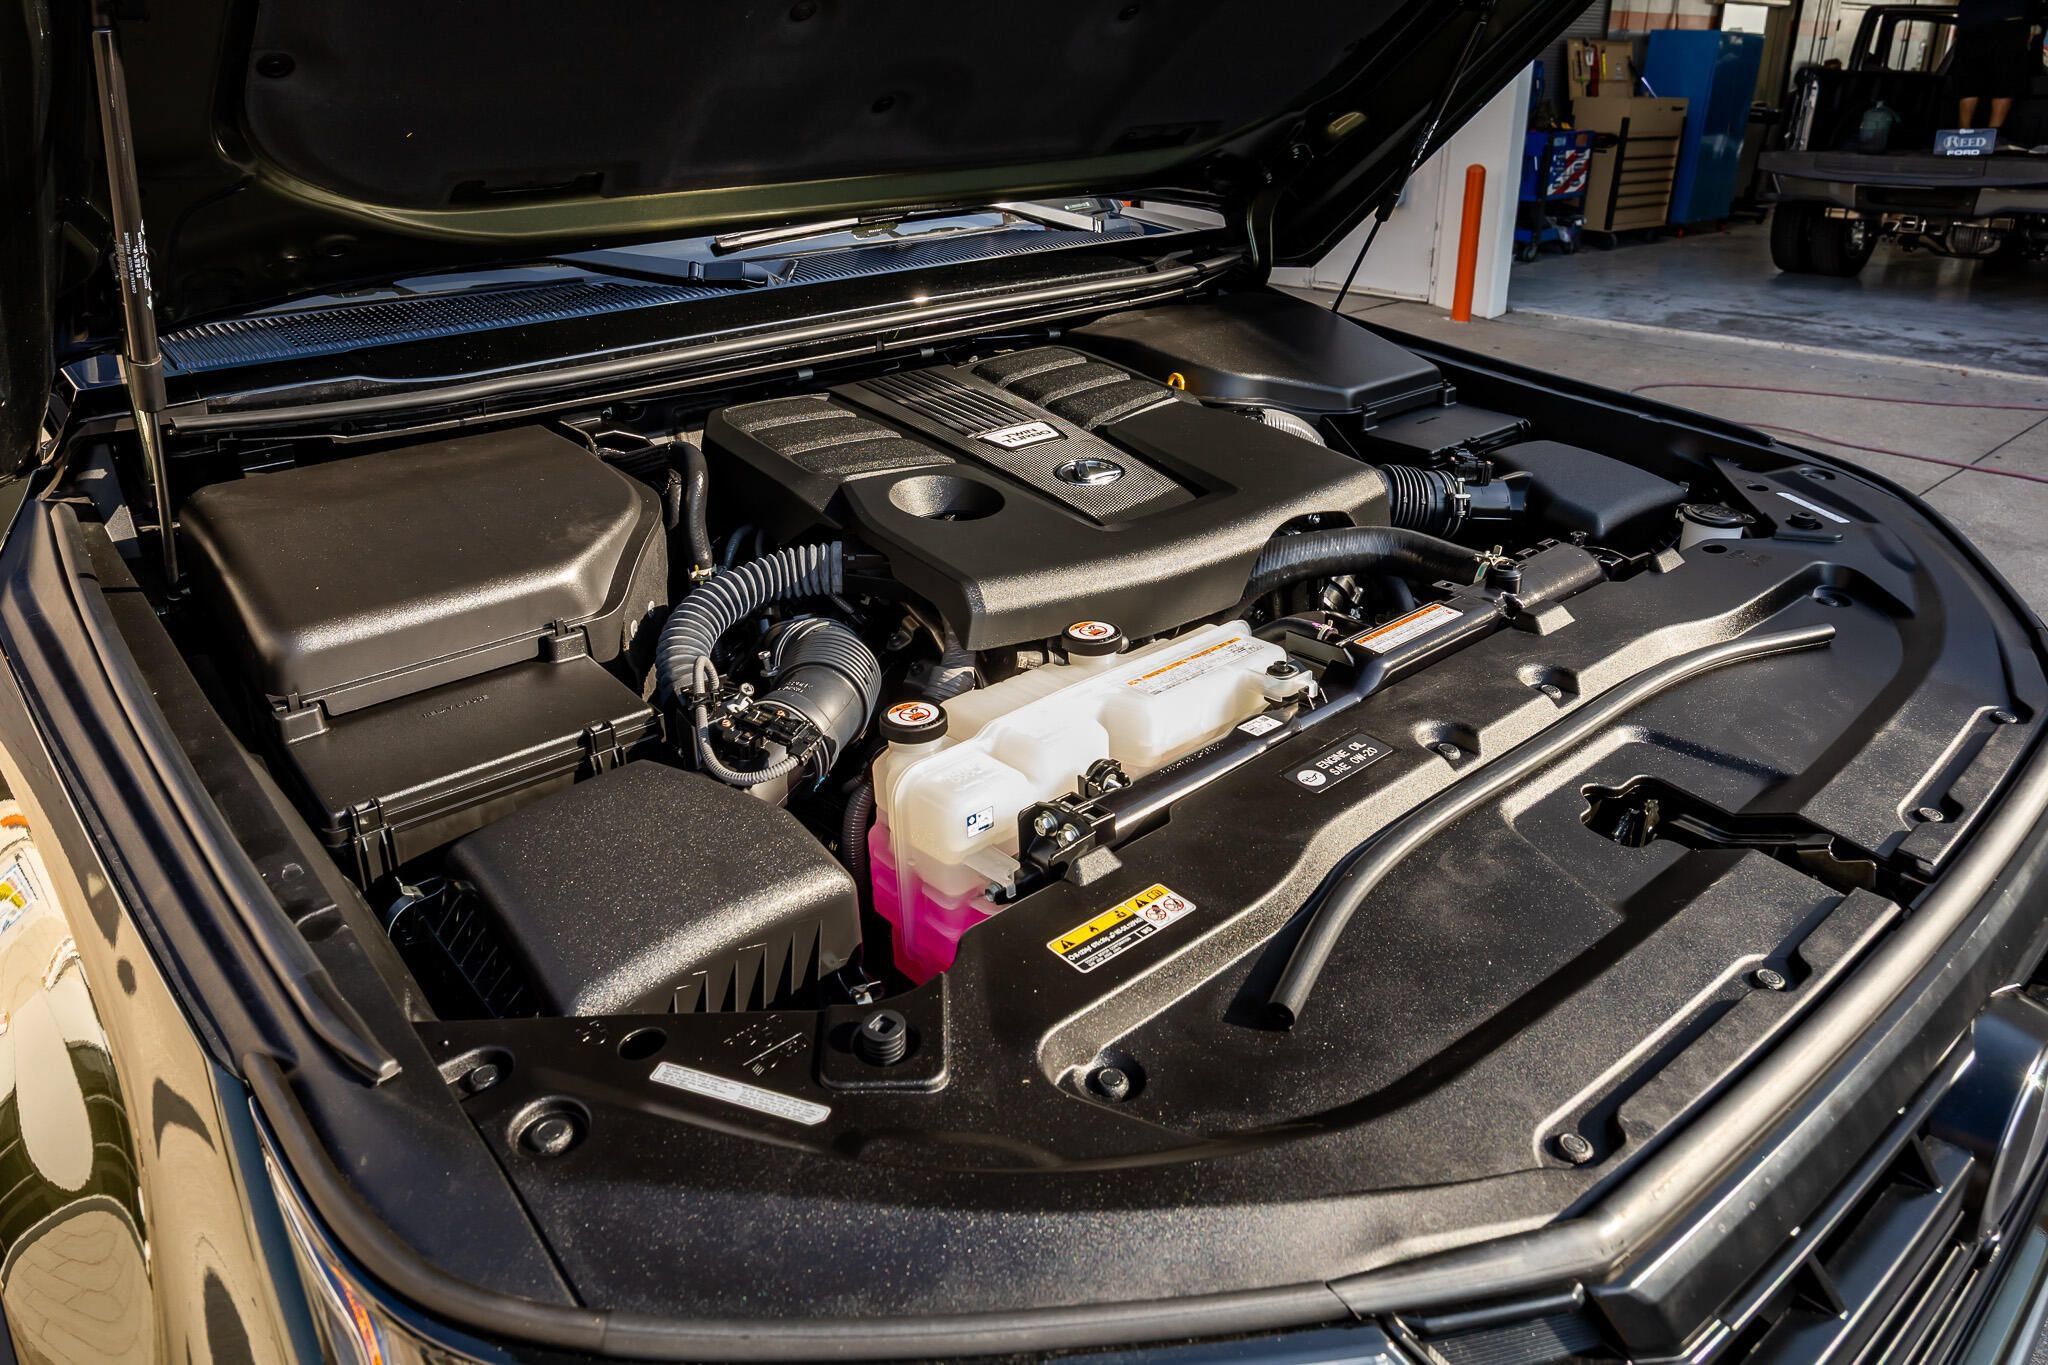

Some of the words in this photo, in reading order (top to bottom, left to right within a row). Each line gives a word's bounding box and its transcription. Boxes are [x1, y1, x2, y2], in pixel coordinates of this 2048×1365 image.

[1943, 135, 1987, 150] REED
[1946, 148, 1981, 156] FORD
[1001, 428, 1038, 438] TWIN
[1001, 430, 1052, 443] TURBO
[1315, 749, 1351, 770] ENGINE
[1348, 741, 1367, 751] OIL
[1329, 761, 1352, 776] SAE
[1349, 746, 1378, 764] 0W-20
